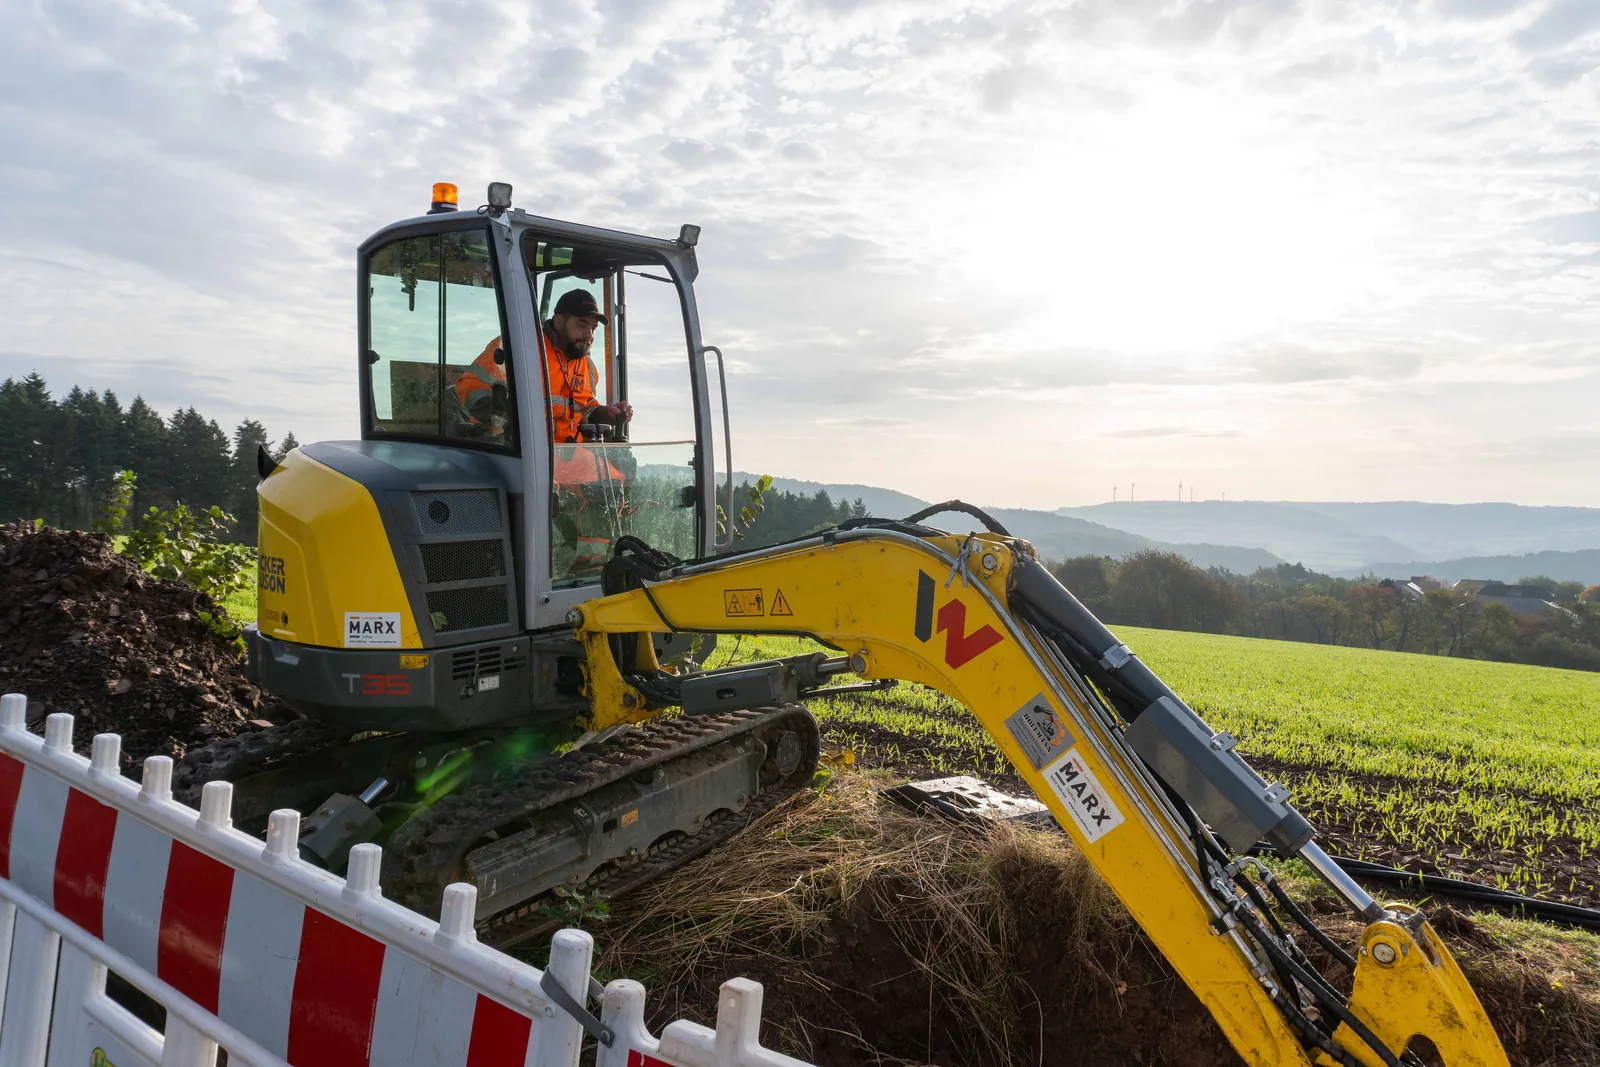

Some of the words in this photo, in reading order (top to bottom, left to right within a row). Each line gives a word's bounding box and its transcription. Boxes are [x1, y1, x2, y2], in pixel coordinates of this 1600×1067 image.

[349, 621, 395, 634] MARX
[341, 673, 411, 695] T35
[1023, 713, 1052, 752] HOFFMANN
[1059, 761, 1111, 827] MARX
